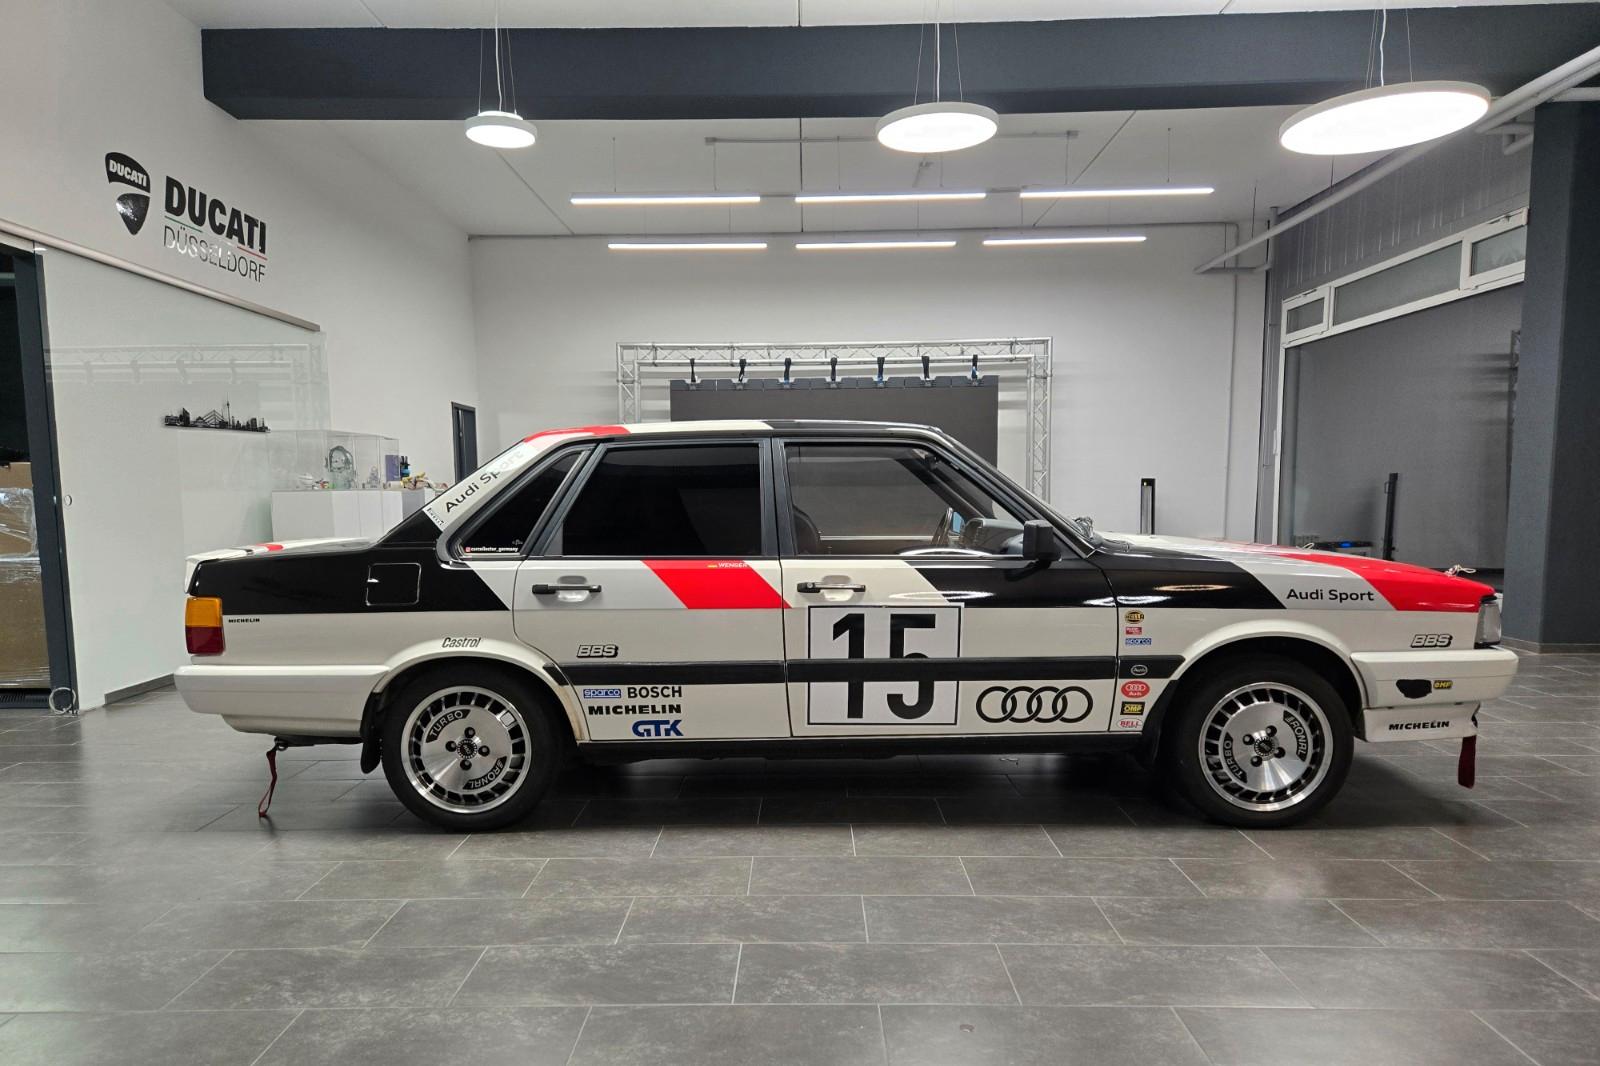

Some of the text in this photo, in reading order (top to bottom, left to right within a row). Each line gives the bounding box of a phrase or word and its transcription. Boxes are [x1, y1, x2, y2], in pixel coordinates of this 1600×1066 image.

[109, 159, 147, 187] DUCATI
[165, 175, 267, 255] DUCATI
[163, 225, 266, 283] DÜSSELDORF
[445, 482, 480, 513] Audi
[1286, 588, 1374, 603] Audi Sport
[441, 637, 481, 648] Castrol
[577, 645, 618, 658] BBS
[1411, 634, 1453, 648] BBS
[833, 613, 936, 719] 15
[584, 686, 683, 698] sparco BOSCH
[588, 704, 682, 715] MICHELIN
[430, 710, 463, 738] TURBO
[632, 720, 684, 737] GTK
[1389, 721, 1450, 731] MICHELIN
[1291, 719, 1306, 755] RONAL
[1223, 740, 1244, 779] TURBO
[470, 765, 502, 789] RONAL
